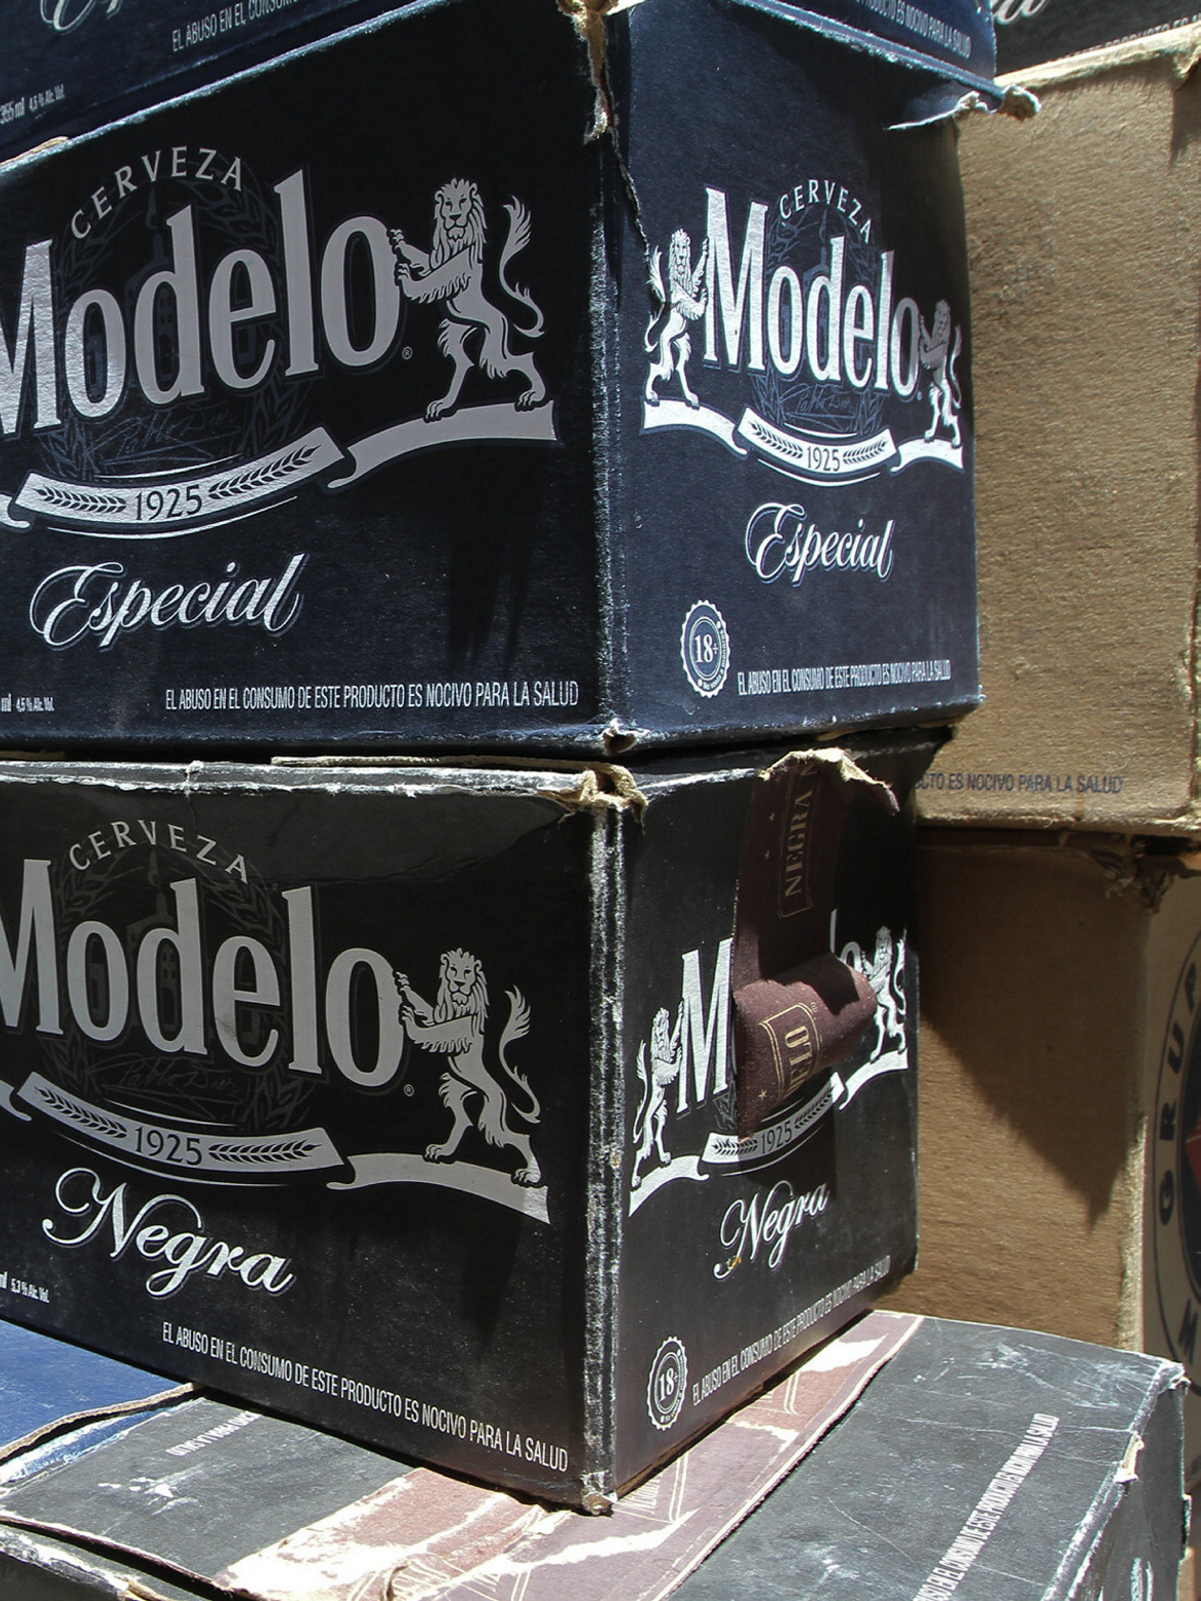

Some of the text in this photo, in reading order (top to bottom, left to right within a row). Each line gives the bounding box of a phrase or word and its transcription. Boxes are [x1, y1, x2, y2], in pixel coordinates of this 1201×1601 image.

[172, 29, 184, 52] EL
[185, 13, 218, 47] ABUSO
[219, 11, 233, 33] EN
[234, 3, 247, 27] EL
[71, 145, 246, 240] CERVEZA
[780, 179, 874, 244] CERVEZA
[704, 187, 920, 396] Modelo
[807, 445, 841, 472] 1925
[135, 485, 202, 520] 1925
[745, 503, 895, 585] Especial
[28, 553, 307, 651] Especial
[165, 680, 579, 710] EL ABUSO EN EL CONSUMO DE ESTE PRODUCTO ES NOCIVO PARA LA SALUD
[738, 671, 748, 695] EL
[748, 670, 772, 695] ABUSO
[782, 669, 792, 692] EL
[792, 667, 824, 691] CONSUMO
[825, 666, 834, 689] DE
[835, 666, 850, 688] ESTE
[882, 663, 890, 685] ES
[950, 773, 964, 791] ES
[967, 773, 1014, 792] NOCIVO
[1018, 774, 1050, 792] PARA
[1056, 775, 1072, 792] LA
[1076, 775, 1124, 794] SALUD
[70, 819, 249, 884] CERVEZA
[784, 788, 814, 898] NEGRA
[134, 1124, 202, 1166] 1925
[761, 1120, 792, 1154] 1925
[42, 1168, 294, 1299] Negra
[713, 1180, 830, 1280] Negra
[163, 1322, 568, 1473] EL ABUSO EN EL CONSUMO DE ESTE PRODUCTO ES NOCIVO PARA LA SALUD
